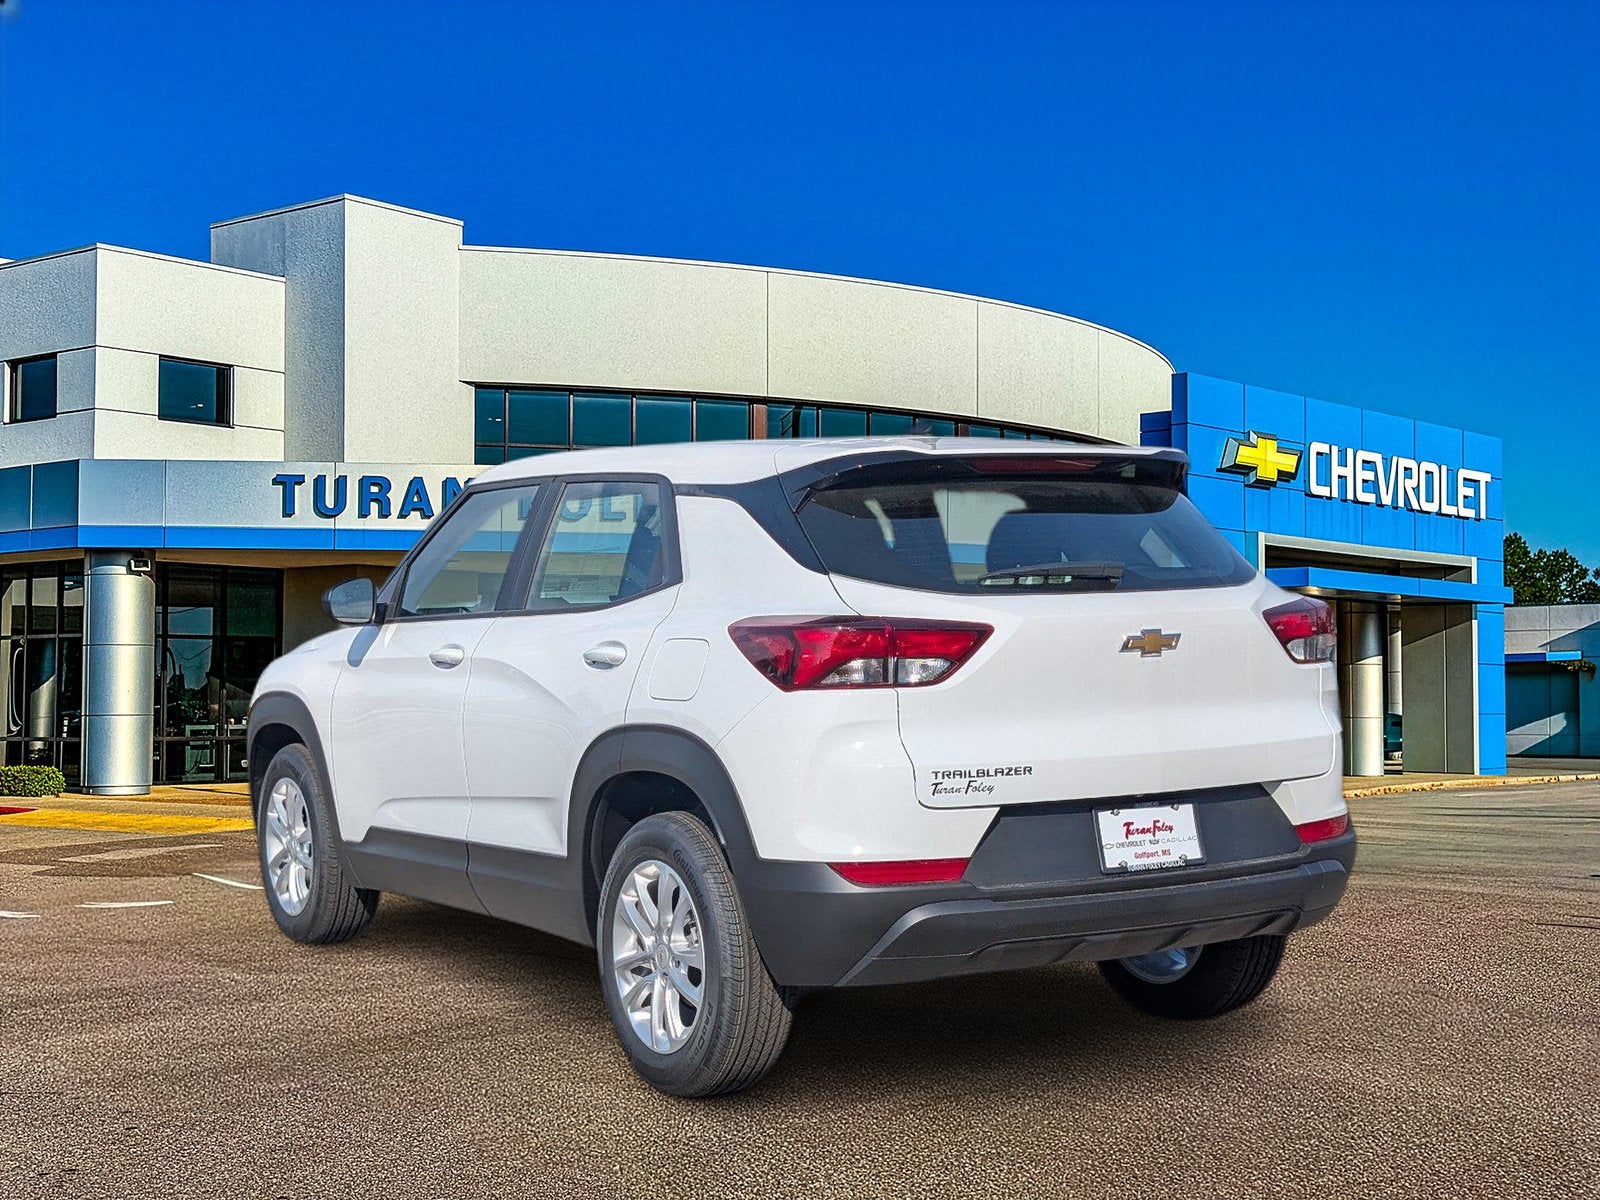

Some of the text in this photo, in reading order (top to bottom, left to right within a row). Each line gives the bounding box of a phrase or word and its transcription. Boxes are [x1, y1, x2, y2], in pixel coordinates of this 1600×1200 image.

[1308, 441, 1492, 520] CHEVROLET
[931, 765, 1033, 780] TRAILBLAZER
[1115, 835, 1198, 849] CHEVROLET CADILLAC
[1161, 848, 1172, 857] MS
